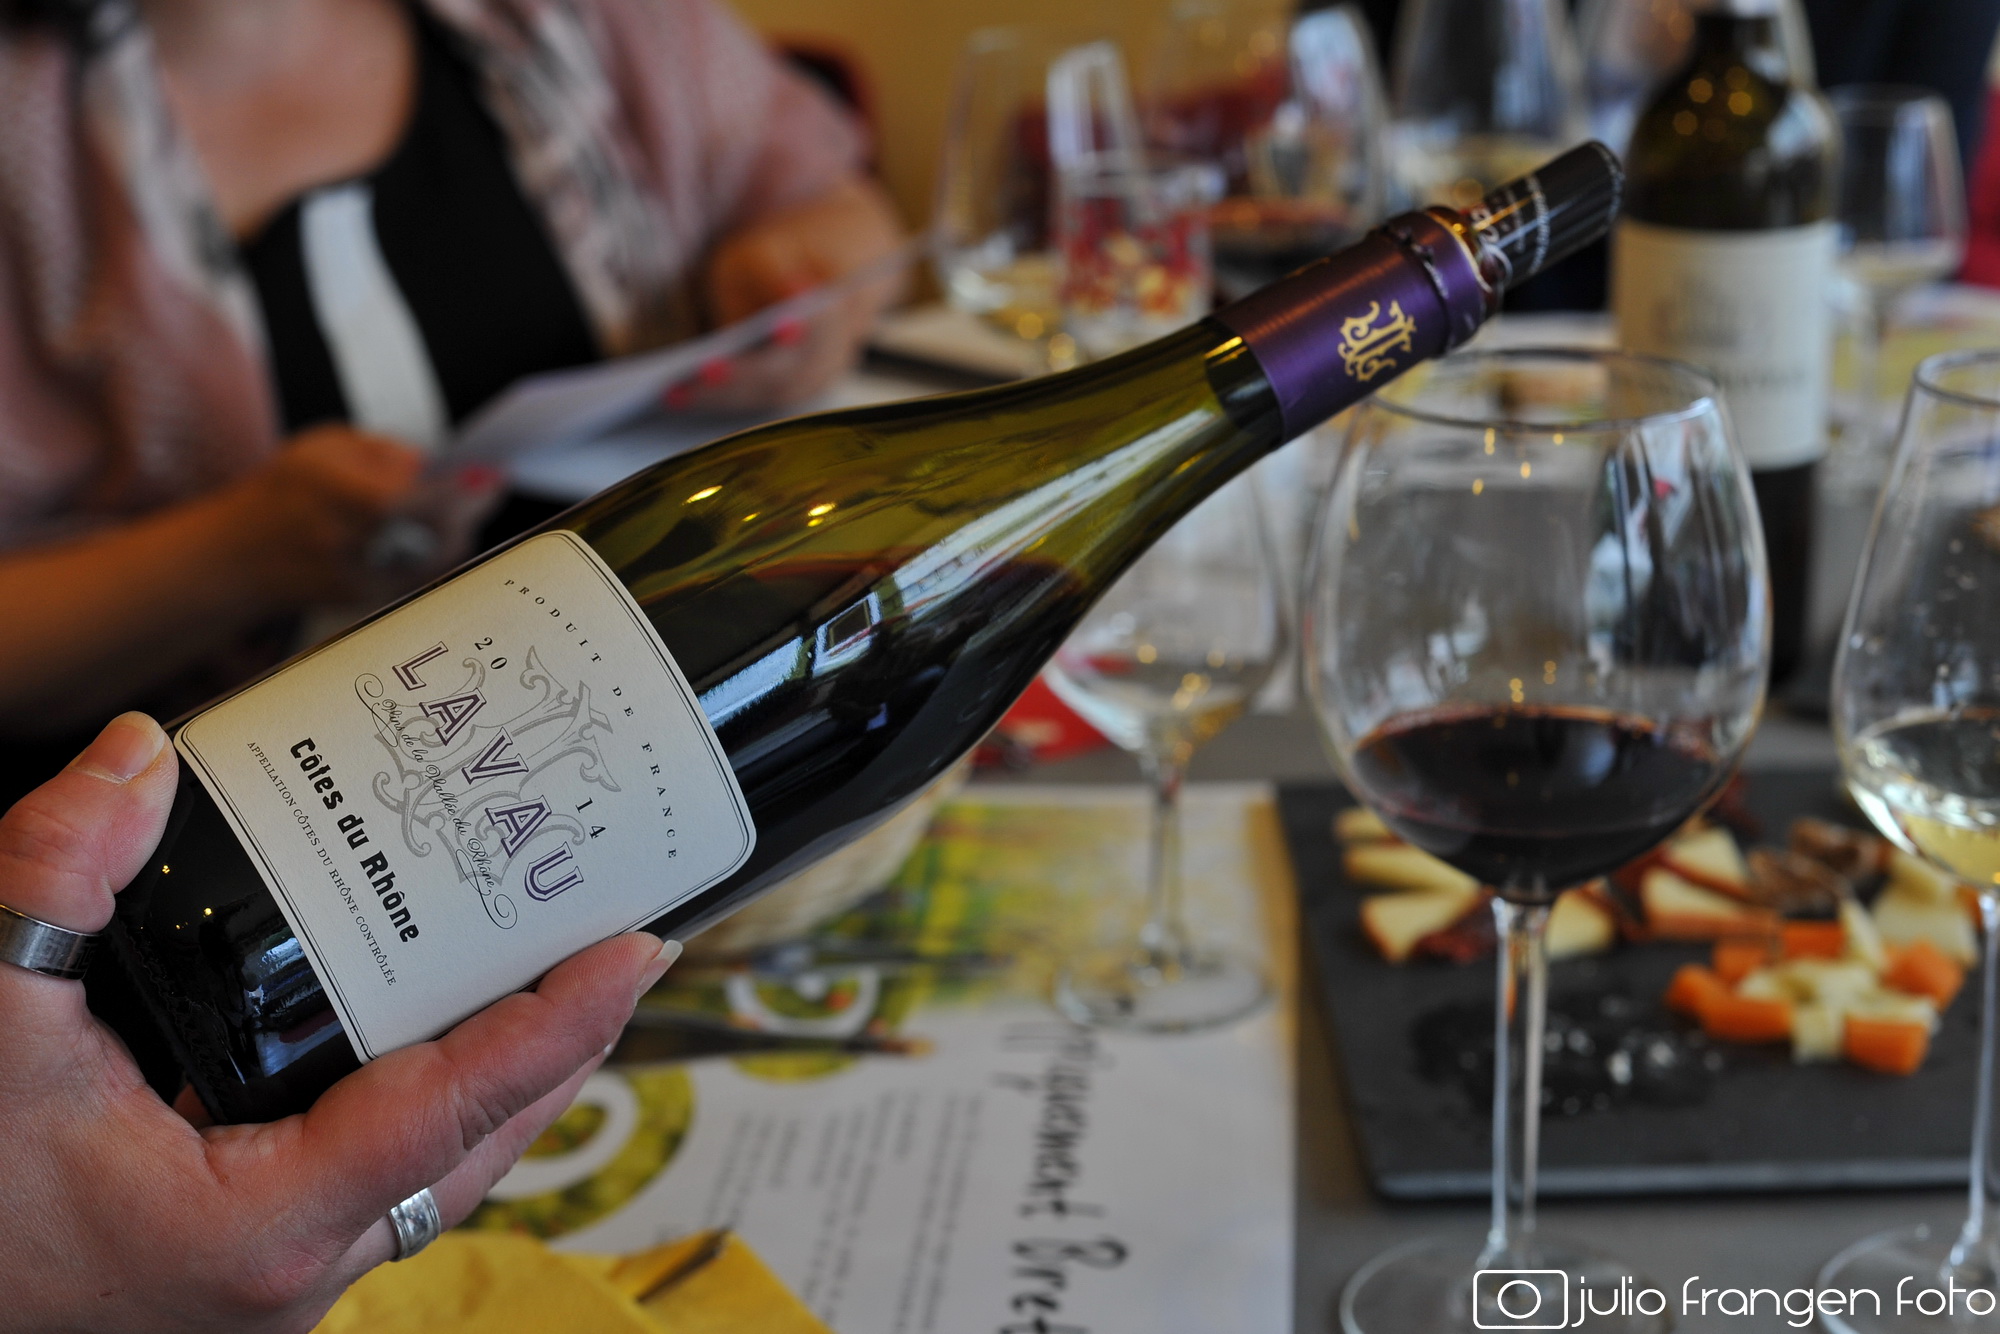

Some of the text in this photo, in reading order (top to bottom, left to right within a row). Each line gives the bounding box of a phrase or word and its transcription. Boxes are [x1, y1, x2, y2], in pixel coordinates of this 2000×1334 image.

[474, 636, 507, 670] 20
[503, 579, 677, 859] PRODUIT DE FRANCE
[247, 741, 397, 986] APPELLATION CÔTES DU RHÔNE CONTRÔLÉE
[290, 737, 420, 943] Côtes du Rhône
[392, 641, 584, 902] LAVAU
[401, 733, 421, 747] de
[412, 749, 429, 763] la
[425, 764, 458, 816] Vallée
[453, 817, 471, 836] du
[575, 797, 607, 840] 14
